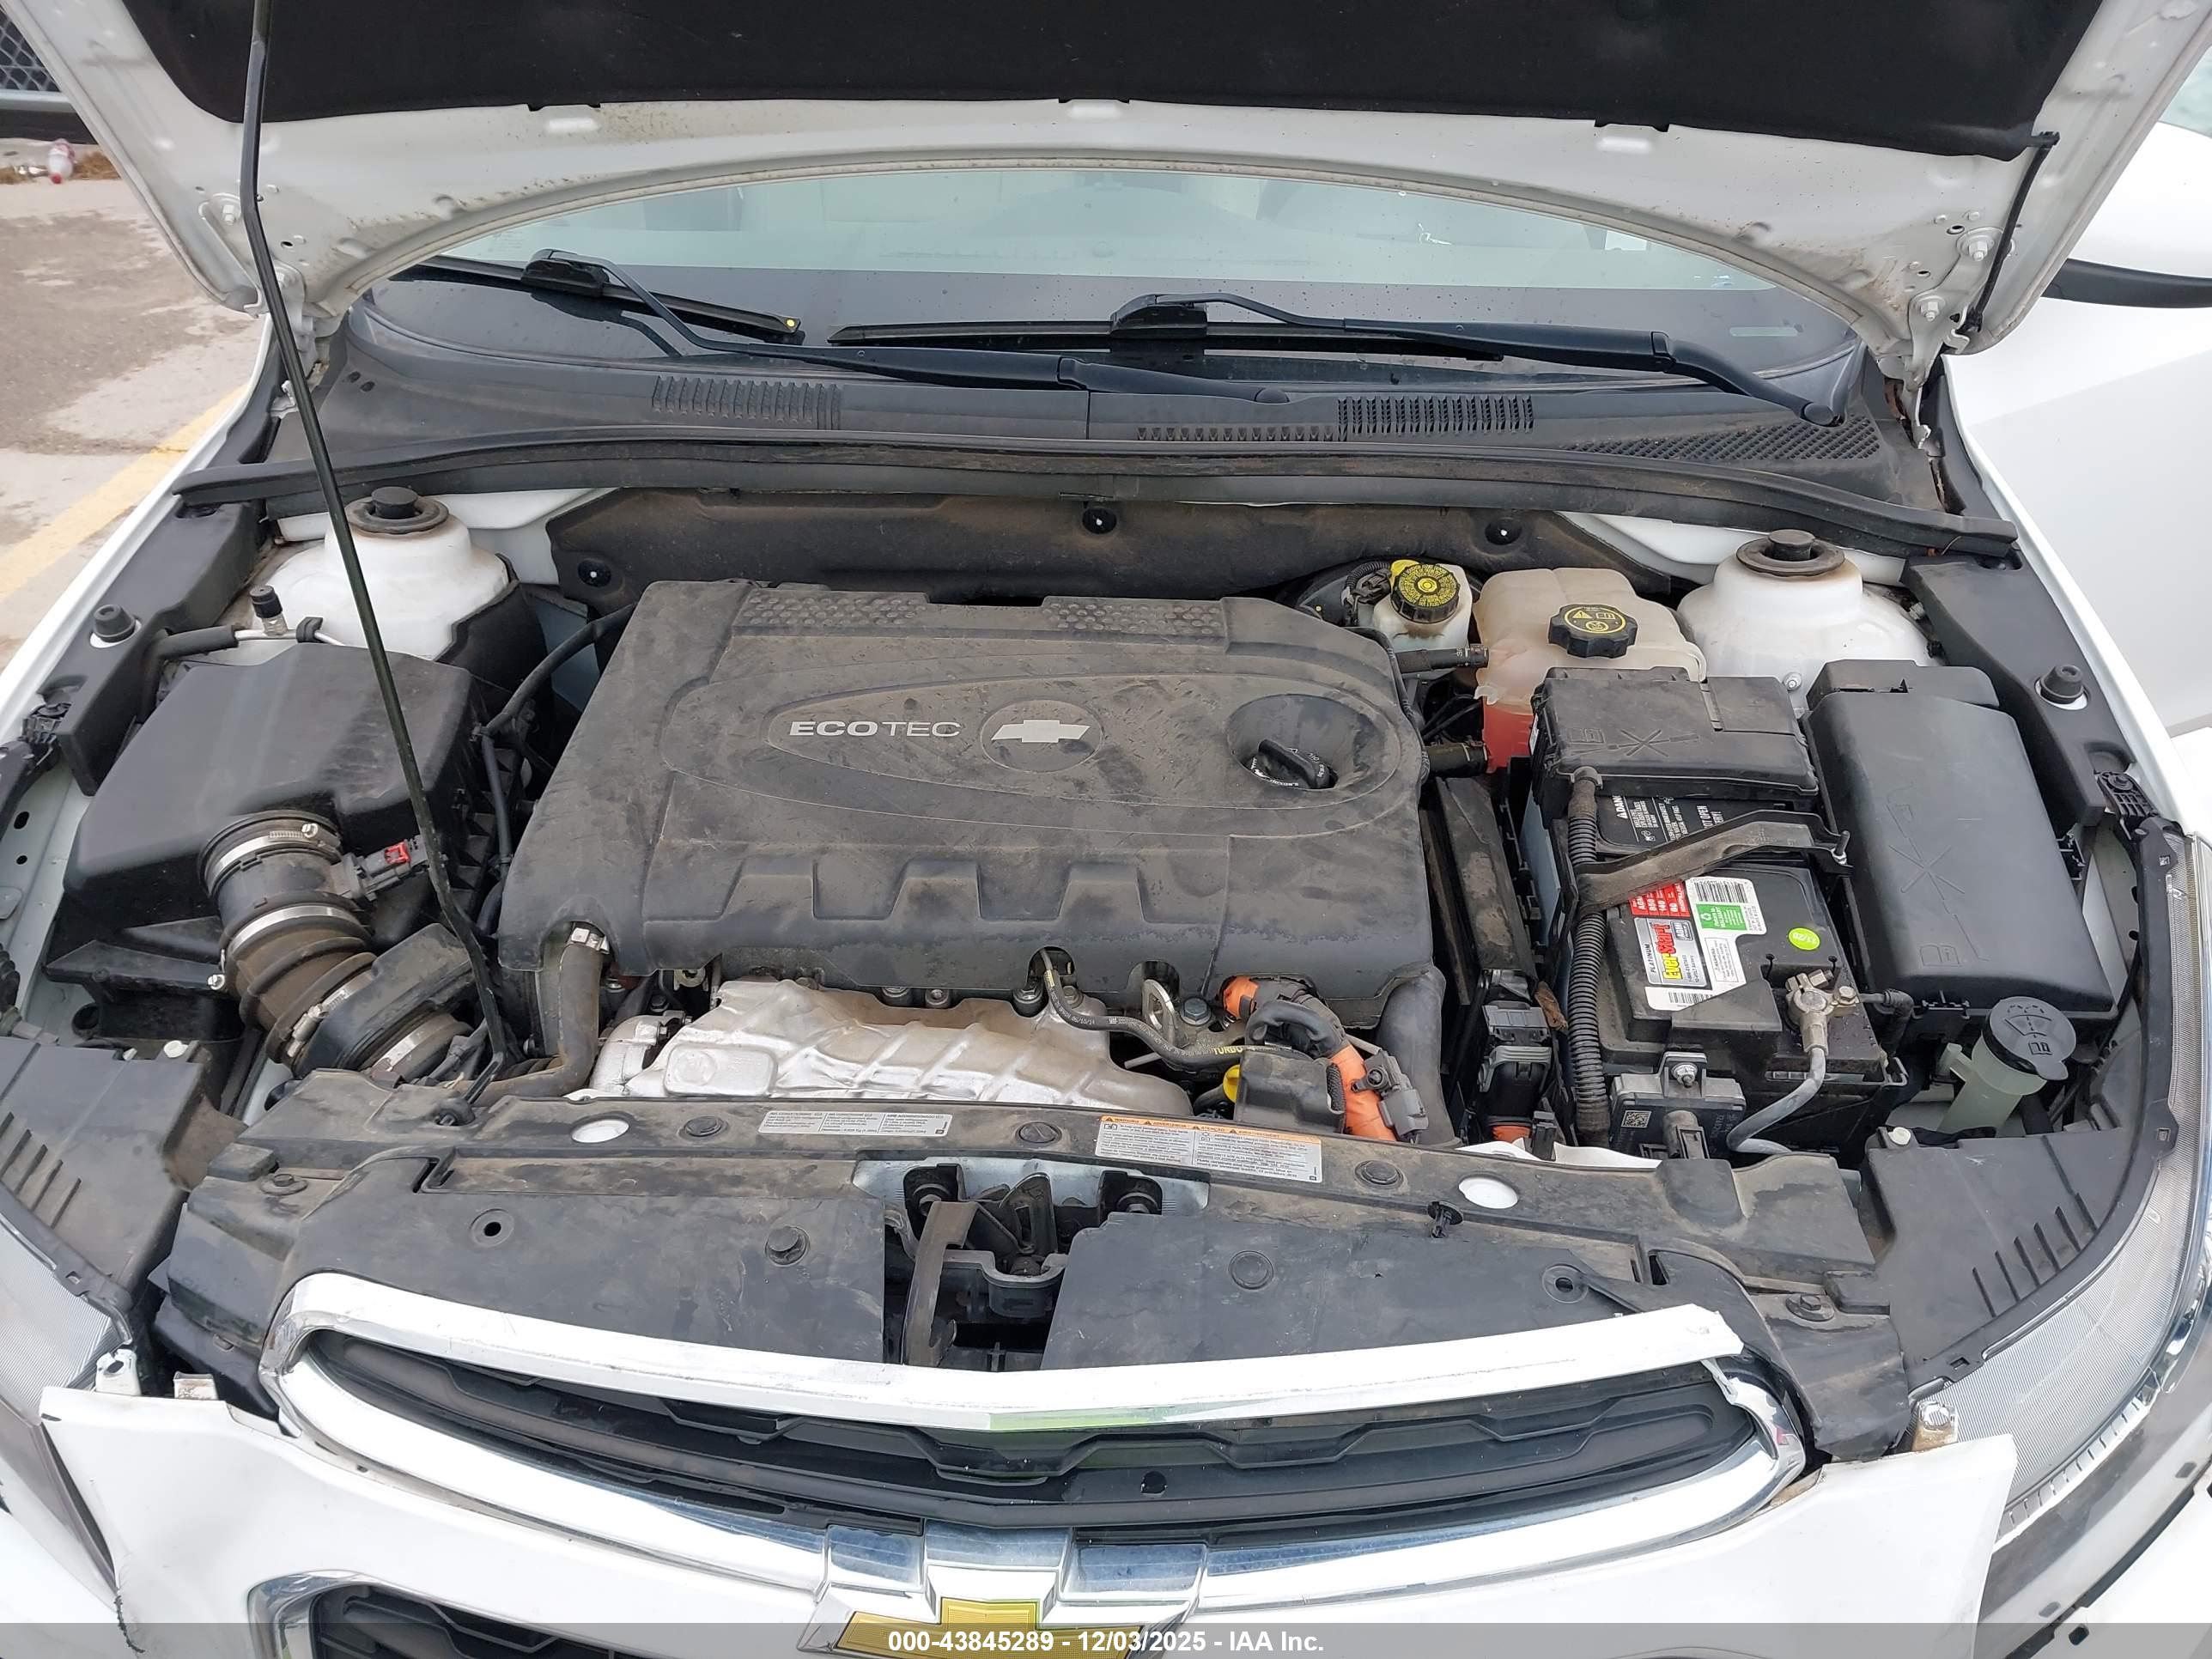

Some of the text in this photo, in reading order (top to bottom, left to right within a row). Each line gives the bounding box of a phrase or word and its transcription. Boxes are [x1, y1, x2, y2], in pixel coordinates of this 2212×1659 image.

[789, 721, 962, 737] ECOTEC
[1697, 805, 1709, 819] OPEN
[1648, 898, 1657, 912] 850
[1658, 900, 1668, 913] 140
[1652, 923, 1683, 980] EverStart
[1644, 944, 1656, 974] PLATINUM
[1213, 1046, 1243, 1055] TURBO
